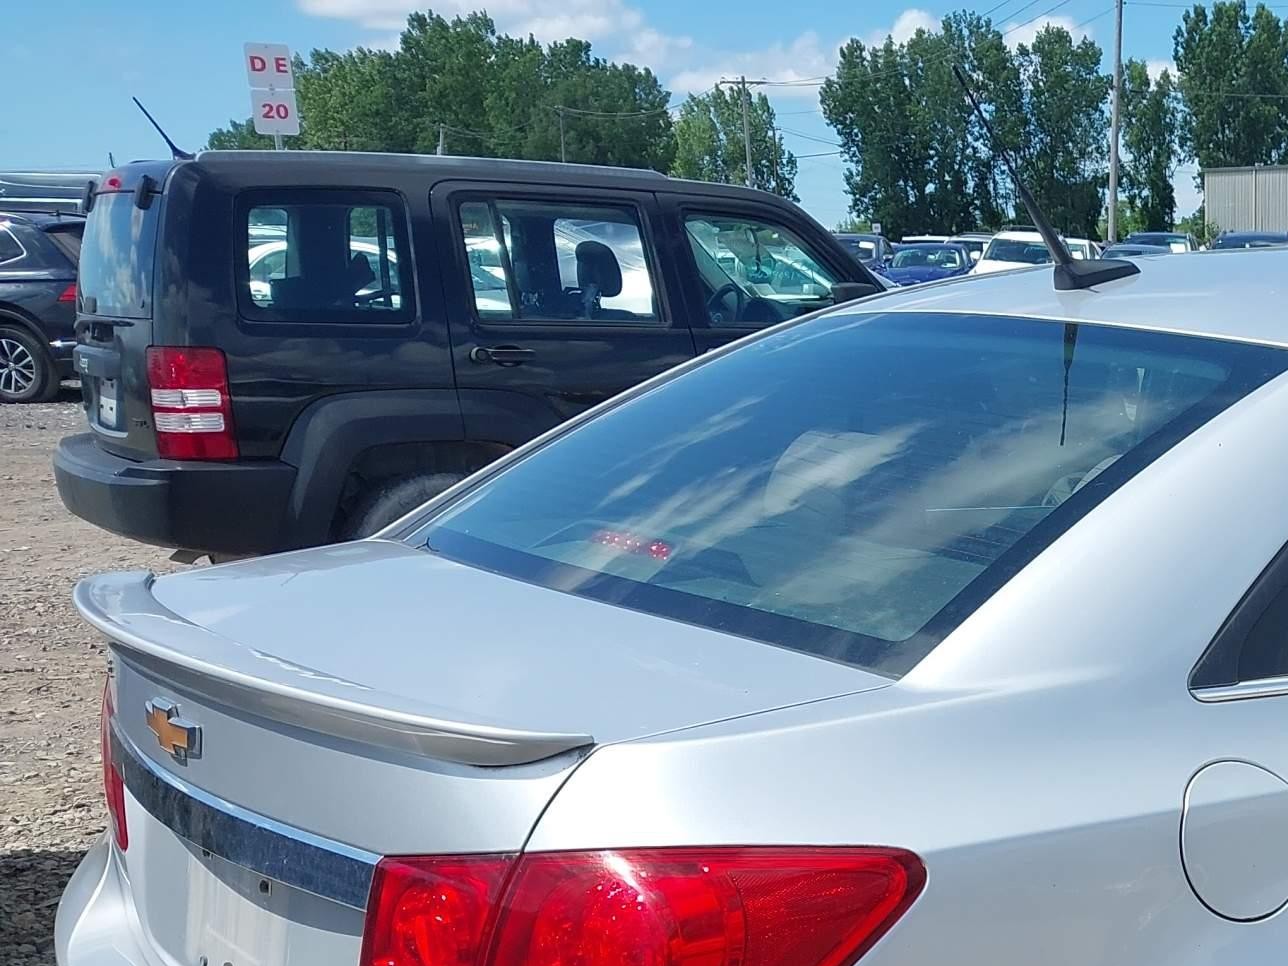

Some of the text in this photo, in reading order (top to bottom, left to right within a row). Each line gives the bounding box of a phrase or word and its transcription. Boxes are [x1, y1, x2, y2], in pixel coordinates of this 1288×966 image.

[249, 56, 288, 73] D E
[261, 103, 289, 119] 20
